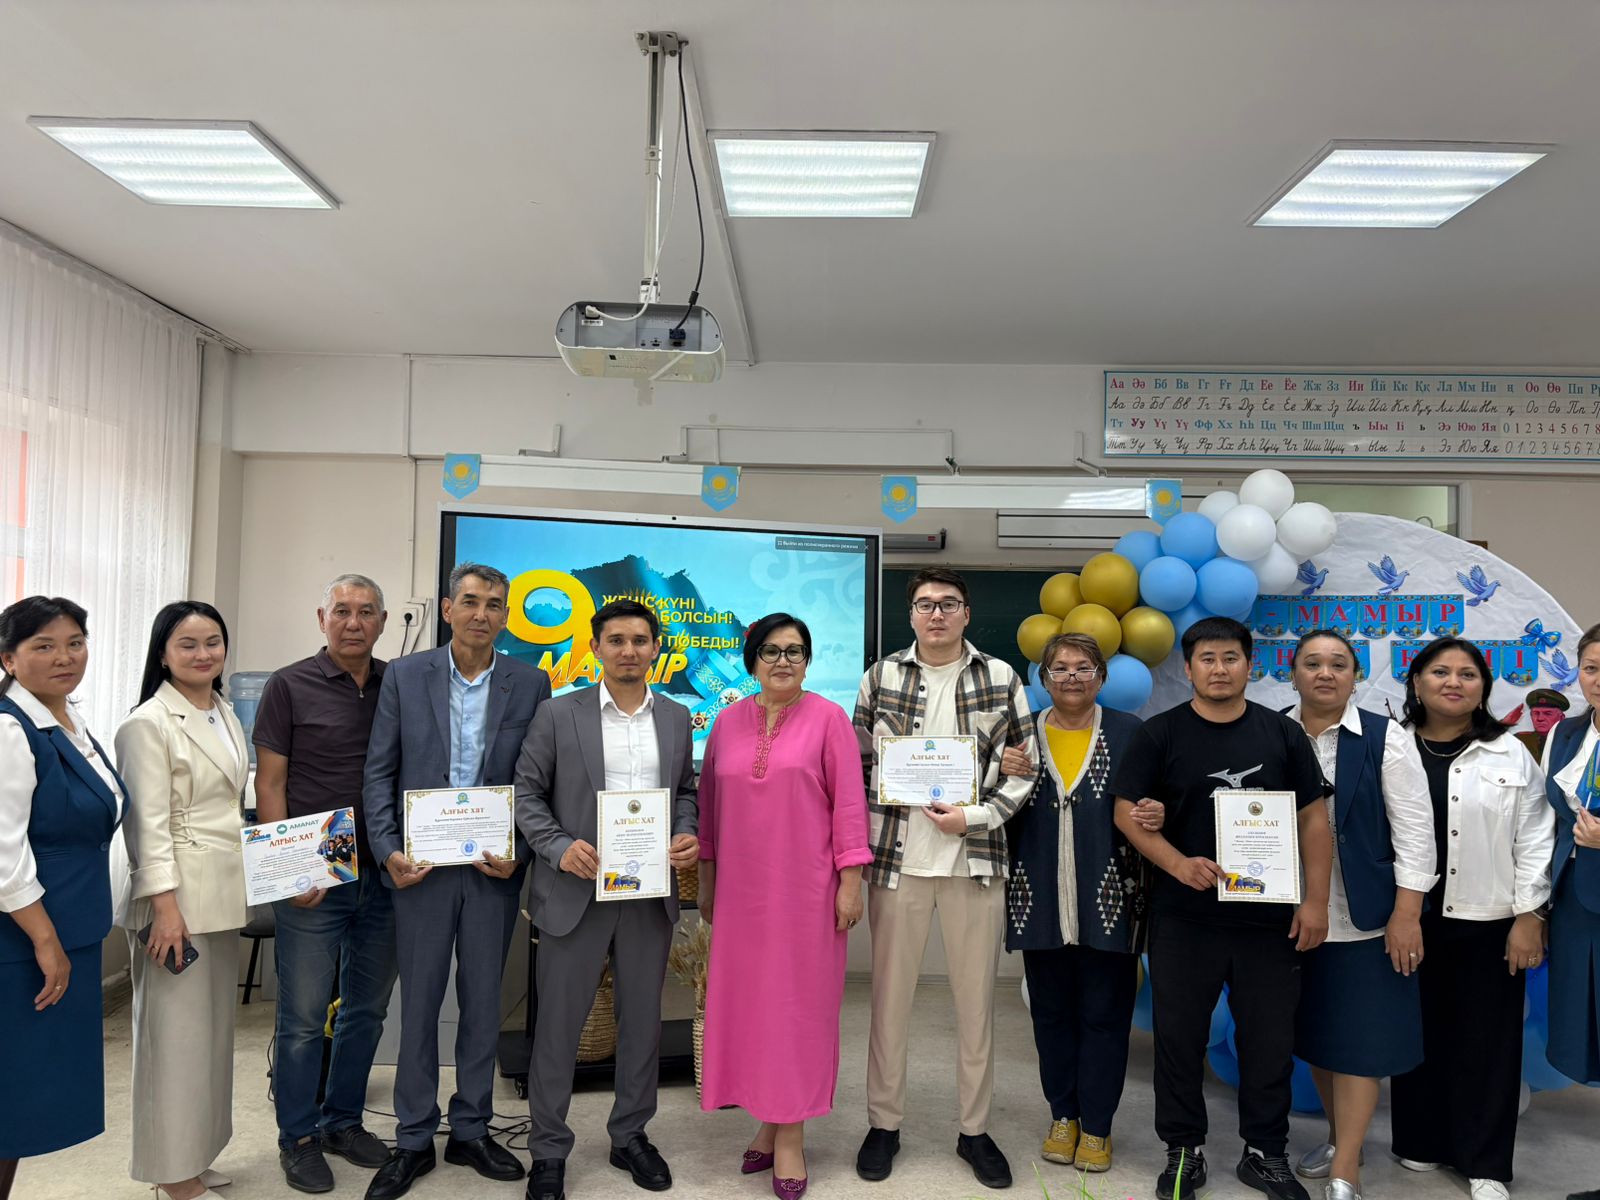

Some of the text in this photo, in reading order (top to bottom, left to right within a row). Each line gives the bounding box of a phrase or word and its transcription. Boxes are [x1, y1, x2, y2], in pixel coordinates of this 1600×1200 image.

[661, 610, 733, 624] БОЛСЫН!
[1298, 603, 1456, 623] МАМЫР
[507, 569, 598, 692] 9
[668, 636, 740, 649] ПОБЕДЫ!
[537, 651, 688, 684] МАЫР
[289, 819, 320, 830] AMANAT
[299, 832, 314, 842] ХАТ
